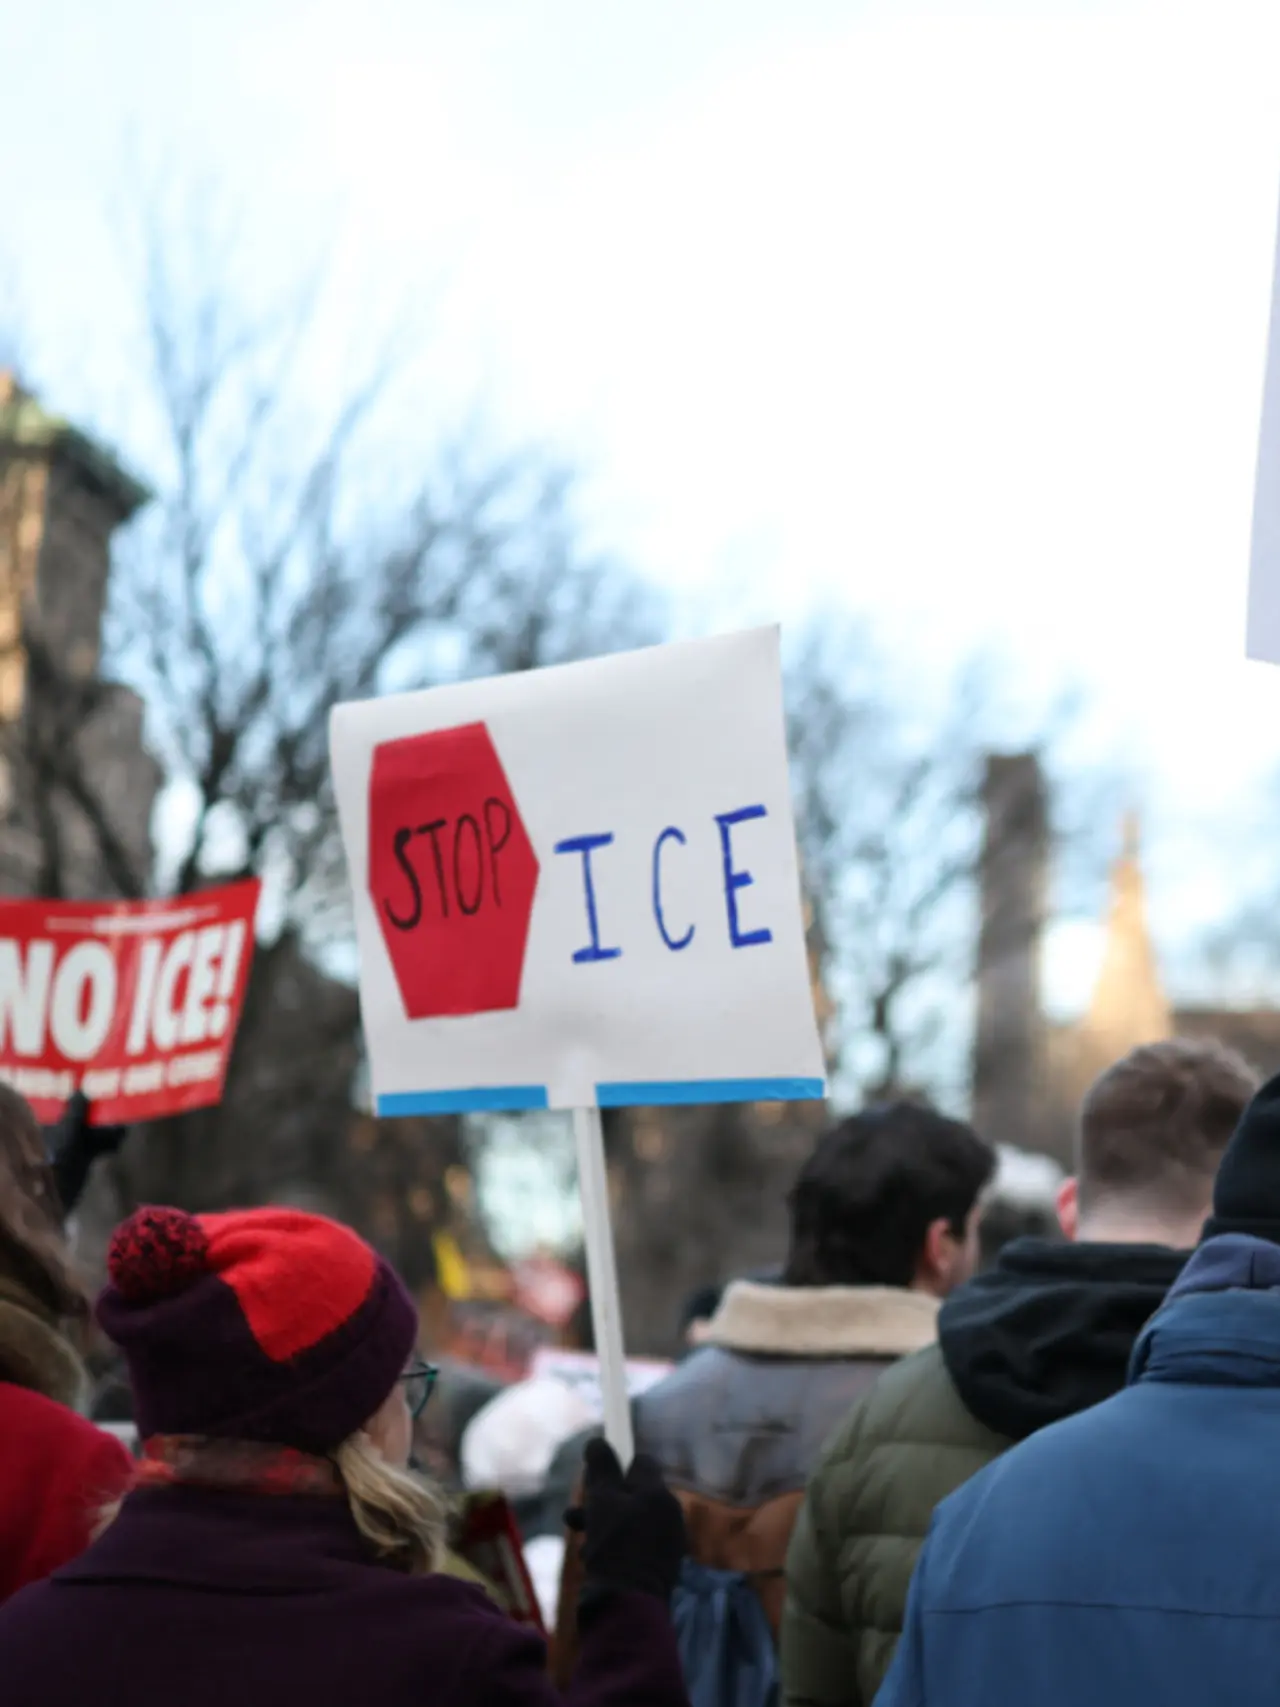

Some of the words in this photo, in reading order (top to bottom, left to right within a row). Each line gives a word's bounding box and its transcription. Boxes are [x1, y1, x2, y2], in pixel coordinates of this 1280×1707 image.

[384, 796, 512, 932] STOP
[553, 803, 773, 965] ICE
[0, 936, 118, 1062] NO
[125, 917, 246, 1055] ICE!
